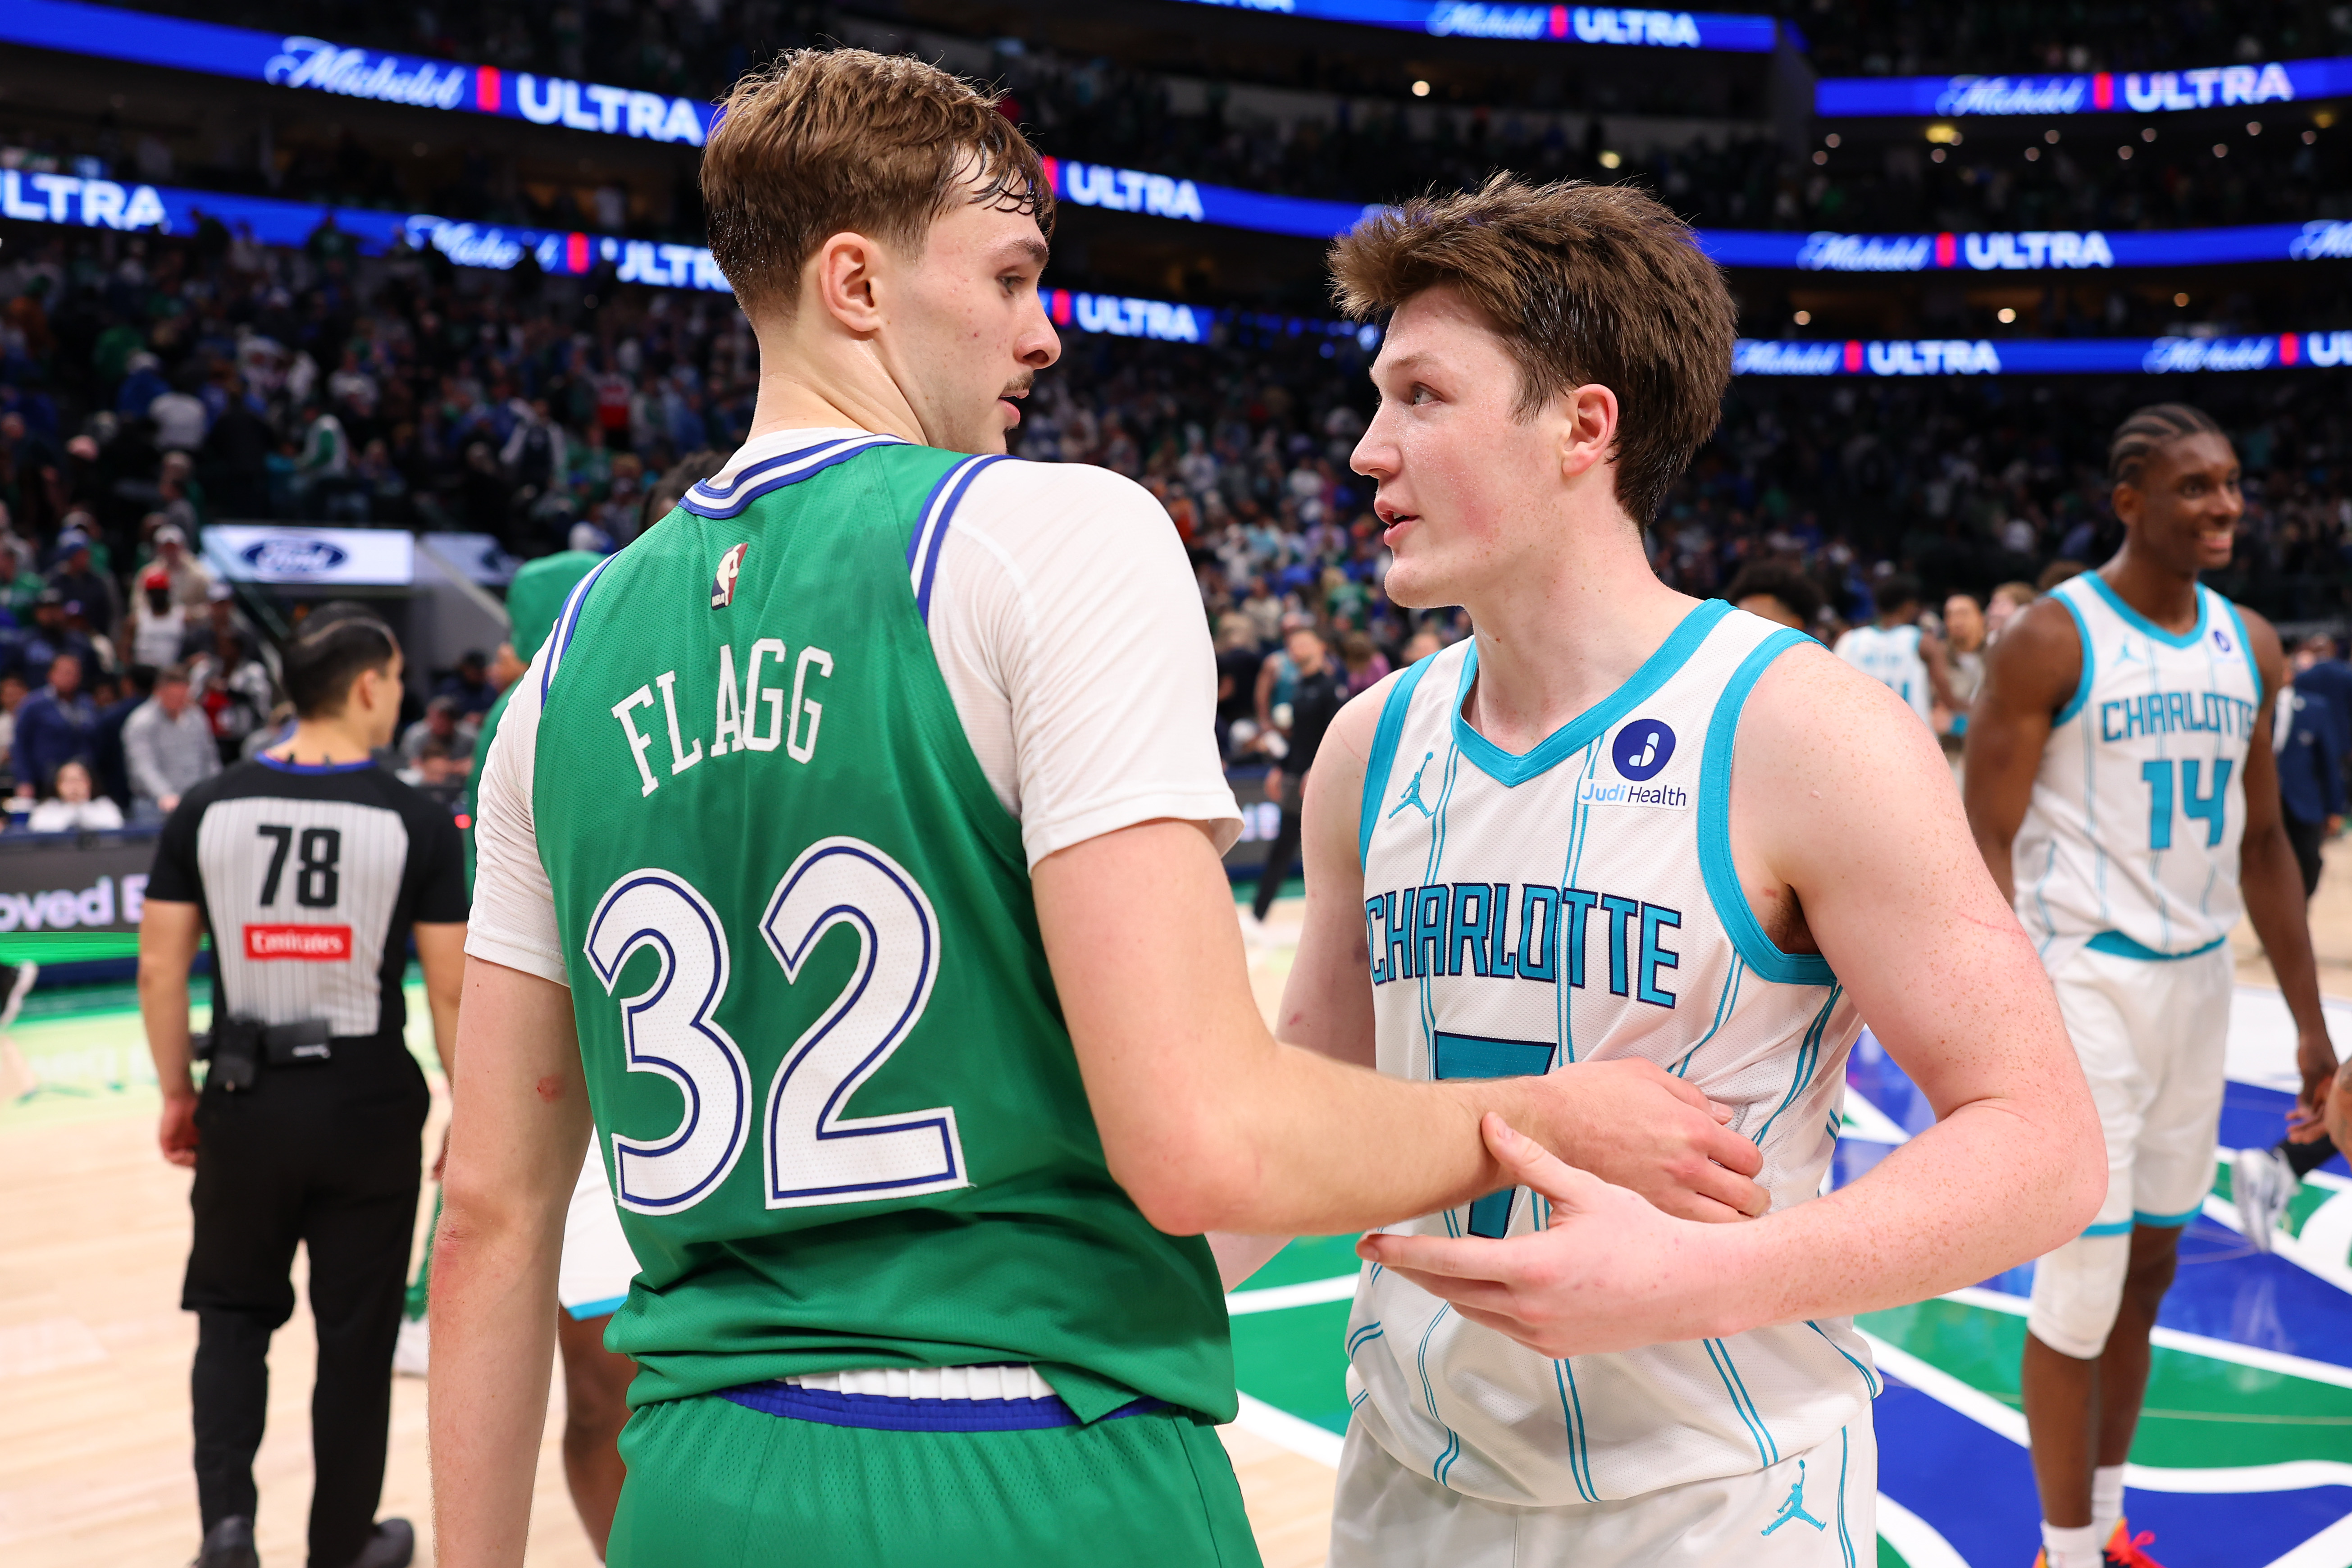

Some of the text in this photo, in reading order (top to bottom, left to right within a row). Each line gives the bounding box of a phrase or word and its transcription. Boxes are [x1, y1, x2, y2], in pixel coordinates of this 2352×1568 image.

[1574, 6, 1701, 47] ULTRA
[264, 36, 706, 147] Michelob ULTRA
[2125, 62, 2295, 112] ULTRA
[0, 169, 166, 231] LTRA
[1066, 161, 1204, 222] ULTRA
[1965, 231, 2114, 270] ULTRA
[1075, 292, 1199, 343] ULTRA
[1868, 339, 2001, 376] ULTRA
[711, 593, 725, 607] NBA
[611, 638, 833, 797] FLAGG
[1582, 783, 1687, 806] Judi Health
[2142, 759, 2233, 850] 14
[258, 825, 340, 907] 78
[251, 929, 344, 954] Emirates
[1365, 882, 1682, 1009] CHARLOTTE
[583, 836, 969, 1216] 32
